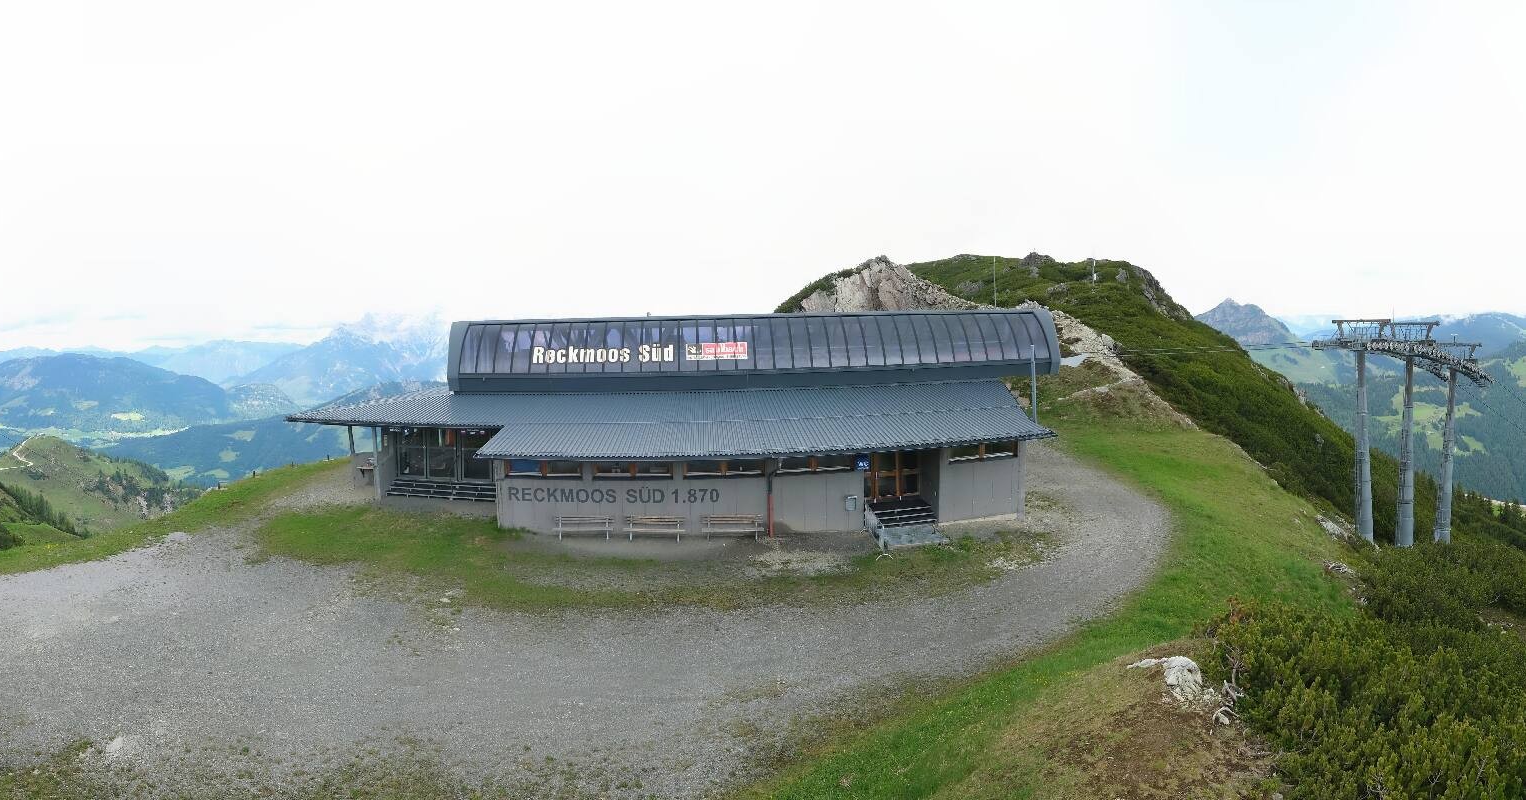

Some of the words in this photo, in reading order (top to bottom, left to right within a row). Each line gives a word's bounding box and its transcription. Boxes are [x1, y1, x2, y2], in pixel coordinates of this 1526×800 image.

[532, 345, 631, 364] Reckmoos
[638, 343, 675, 363] Süd
[508, 486, 617, 504] RECKMOOS
[625, 486, 666, 504] SÜD
[671, 488, 721, 504] 1.870
